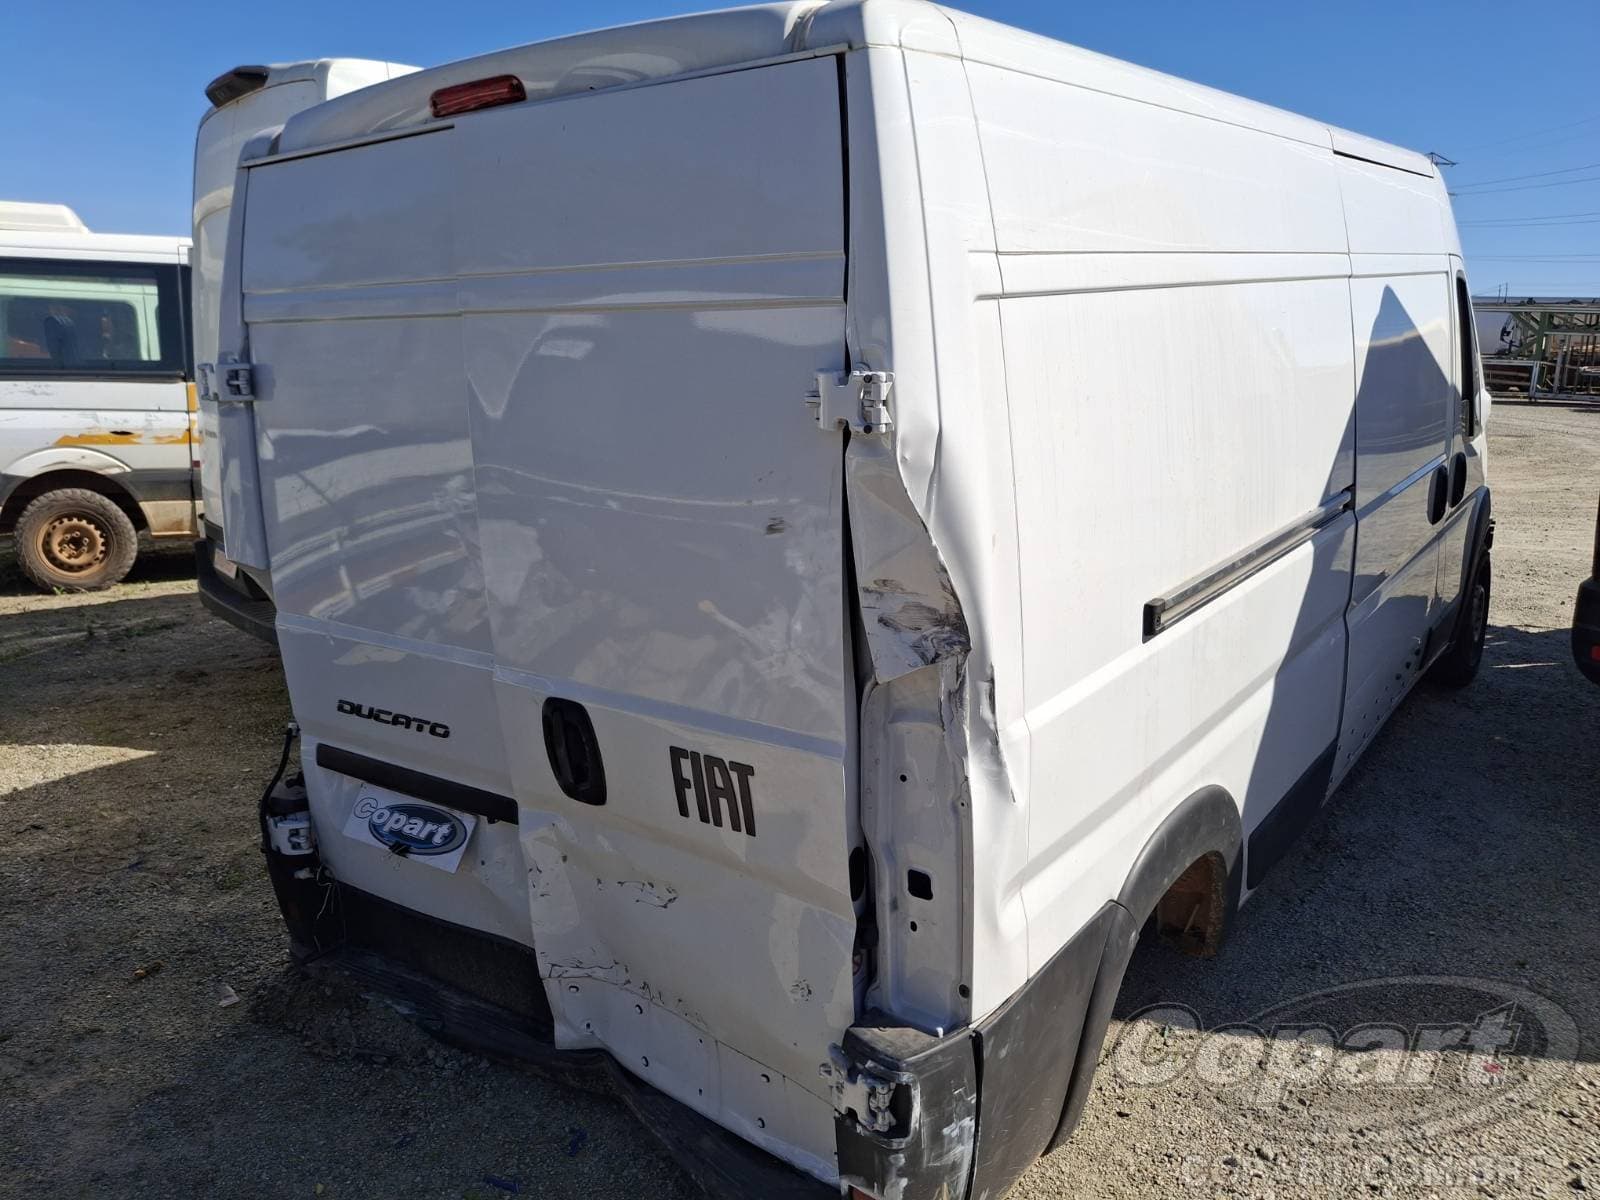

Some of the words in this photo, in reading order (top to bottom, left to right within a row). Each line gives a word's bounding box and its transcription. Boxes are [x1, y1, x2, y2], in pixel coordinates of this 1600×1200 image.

[337, 699, 451, 739] DUCATO
[669, 745, 757, 837] FIAT
[353, 797, 452, 846] Copart
